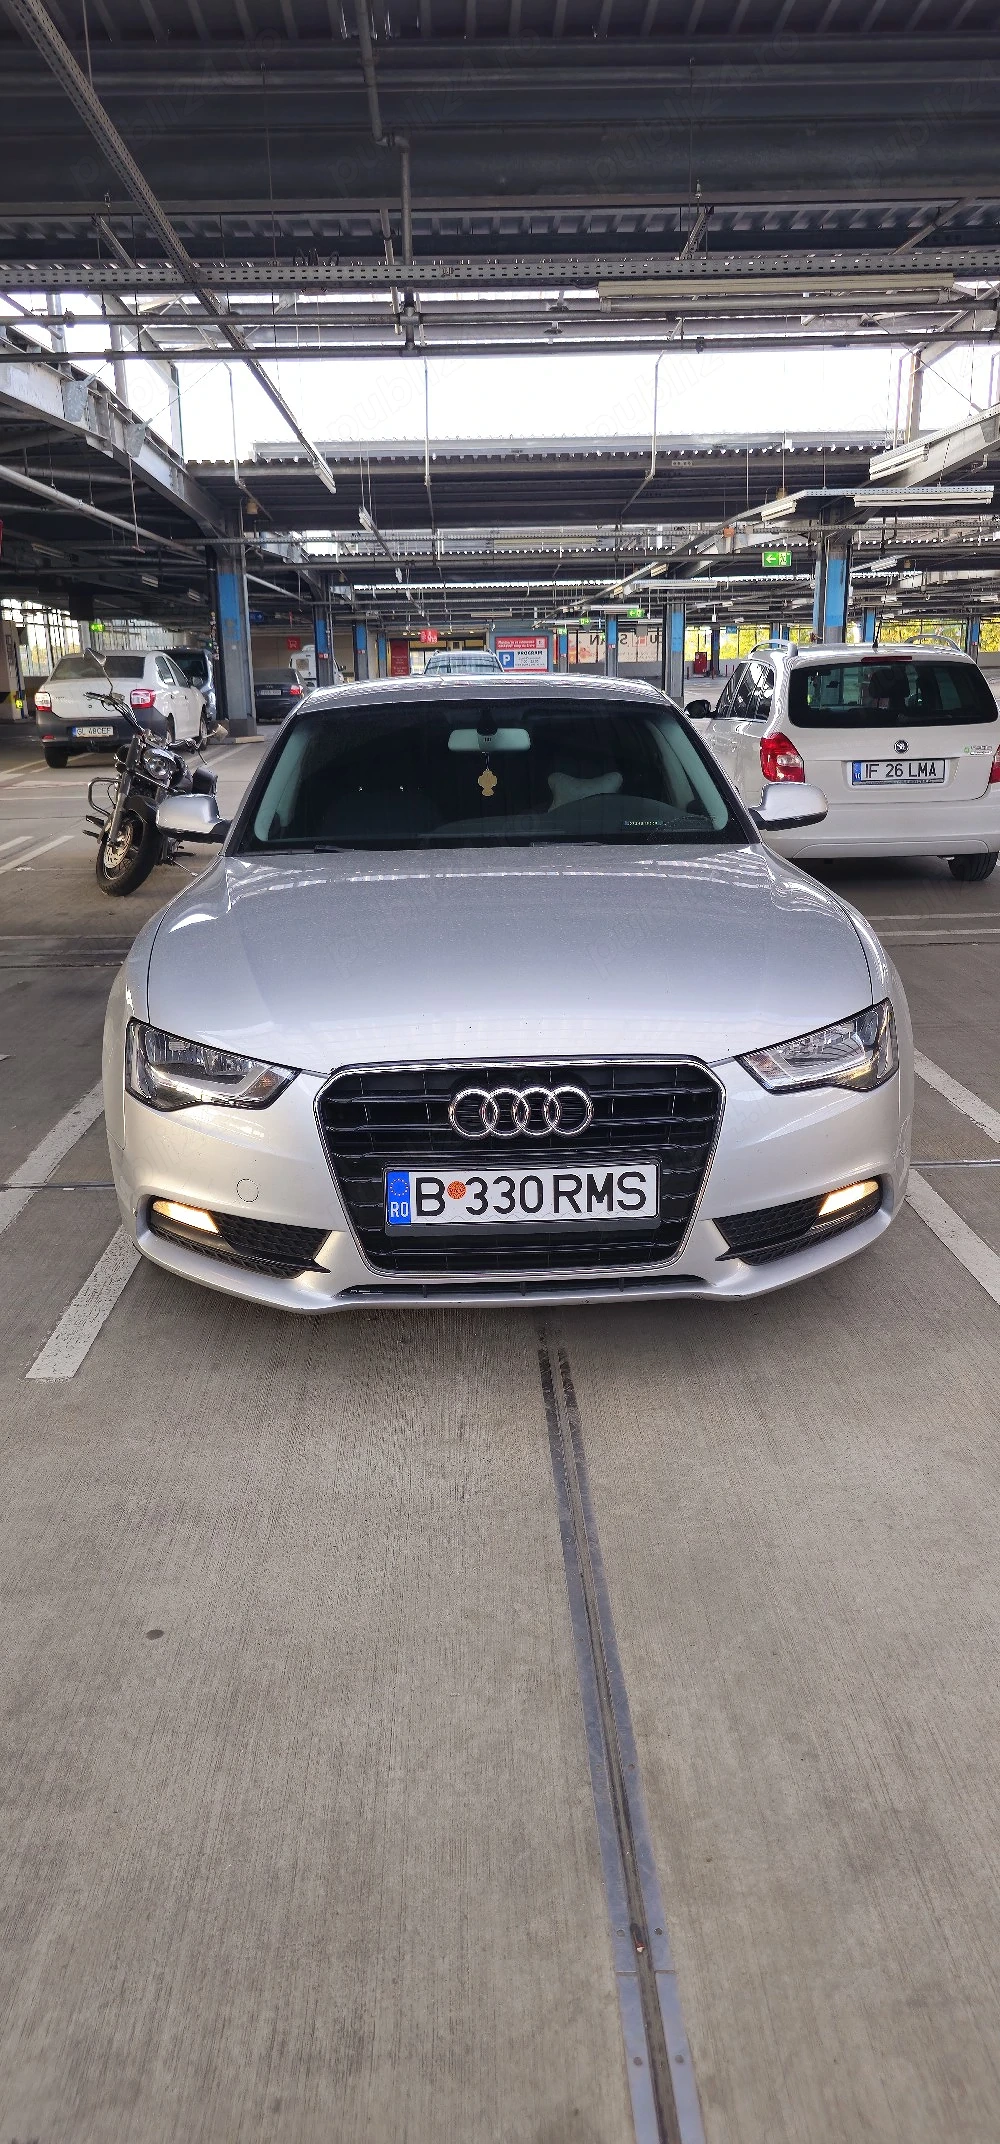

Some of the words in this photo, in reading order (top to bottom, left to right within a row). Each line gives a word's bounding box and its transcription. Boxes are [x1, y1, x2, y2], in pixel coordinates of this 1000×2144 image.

[503, 654, 510, 665] P
[865, 763, 879, 779] IF
[885, 763, 904, 778] 26
[908, 762, 937, 778] LMA
[416, 1176, 446, 1217] B
[465, 1174, 544, 1216] 330
[553, 1170, 647, 1214] RMS
[390, 1200, 409, 1219] RO
